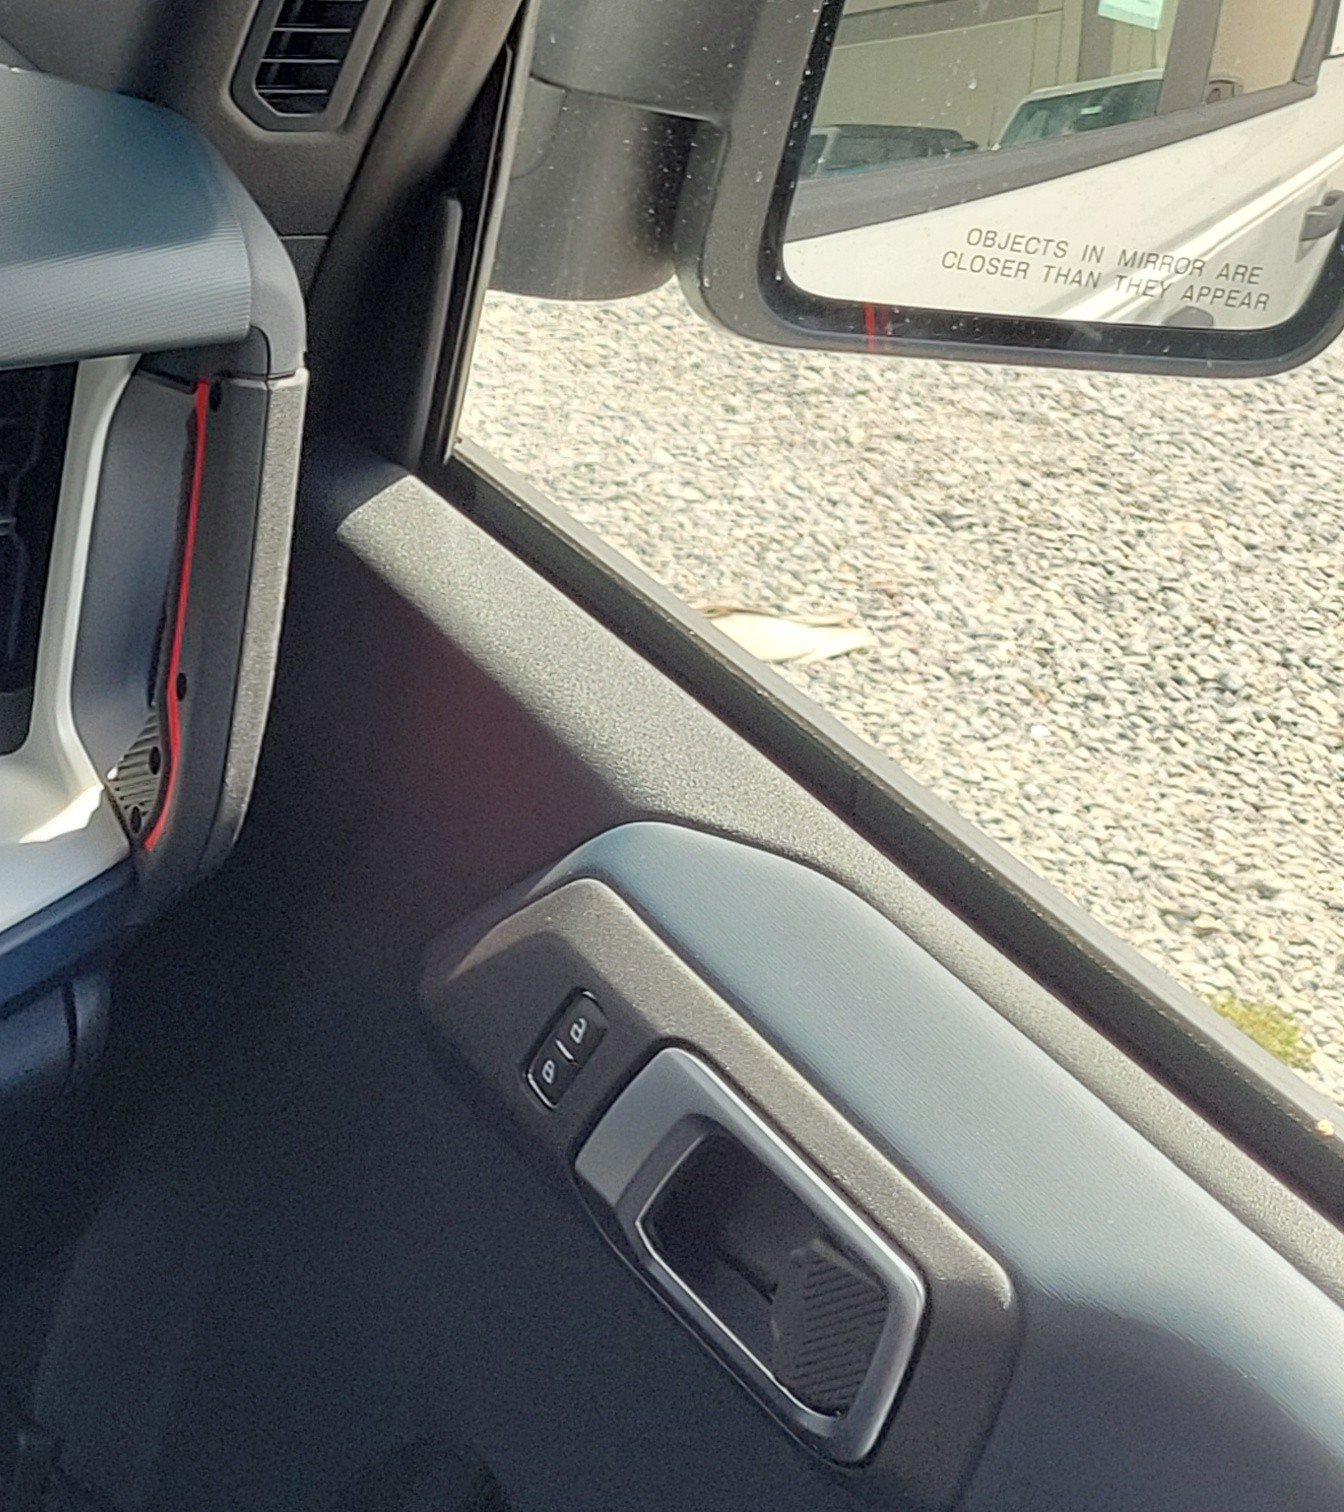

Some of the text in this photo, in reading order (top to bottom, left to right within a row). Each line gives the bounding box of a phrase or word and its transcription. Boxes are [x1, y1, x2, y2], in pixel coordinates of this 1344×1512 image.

[941, 251, 1271, 311] CLOSER THAN THEY APPEAR
[965, 227, 1263, 286] OBJECTS IN MIRROR ARE
